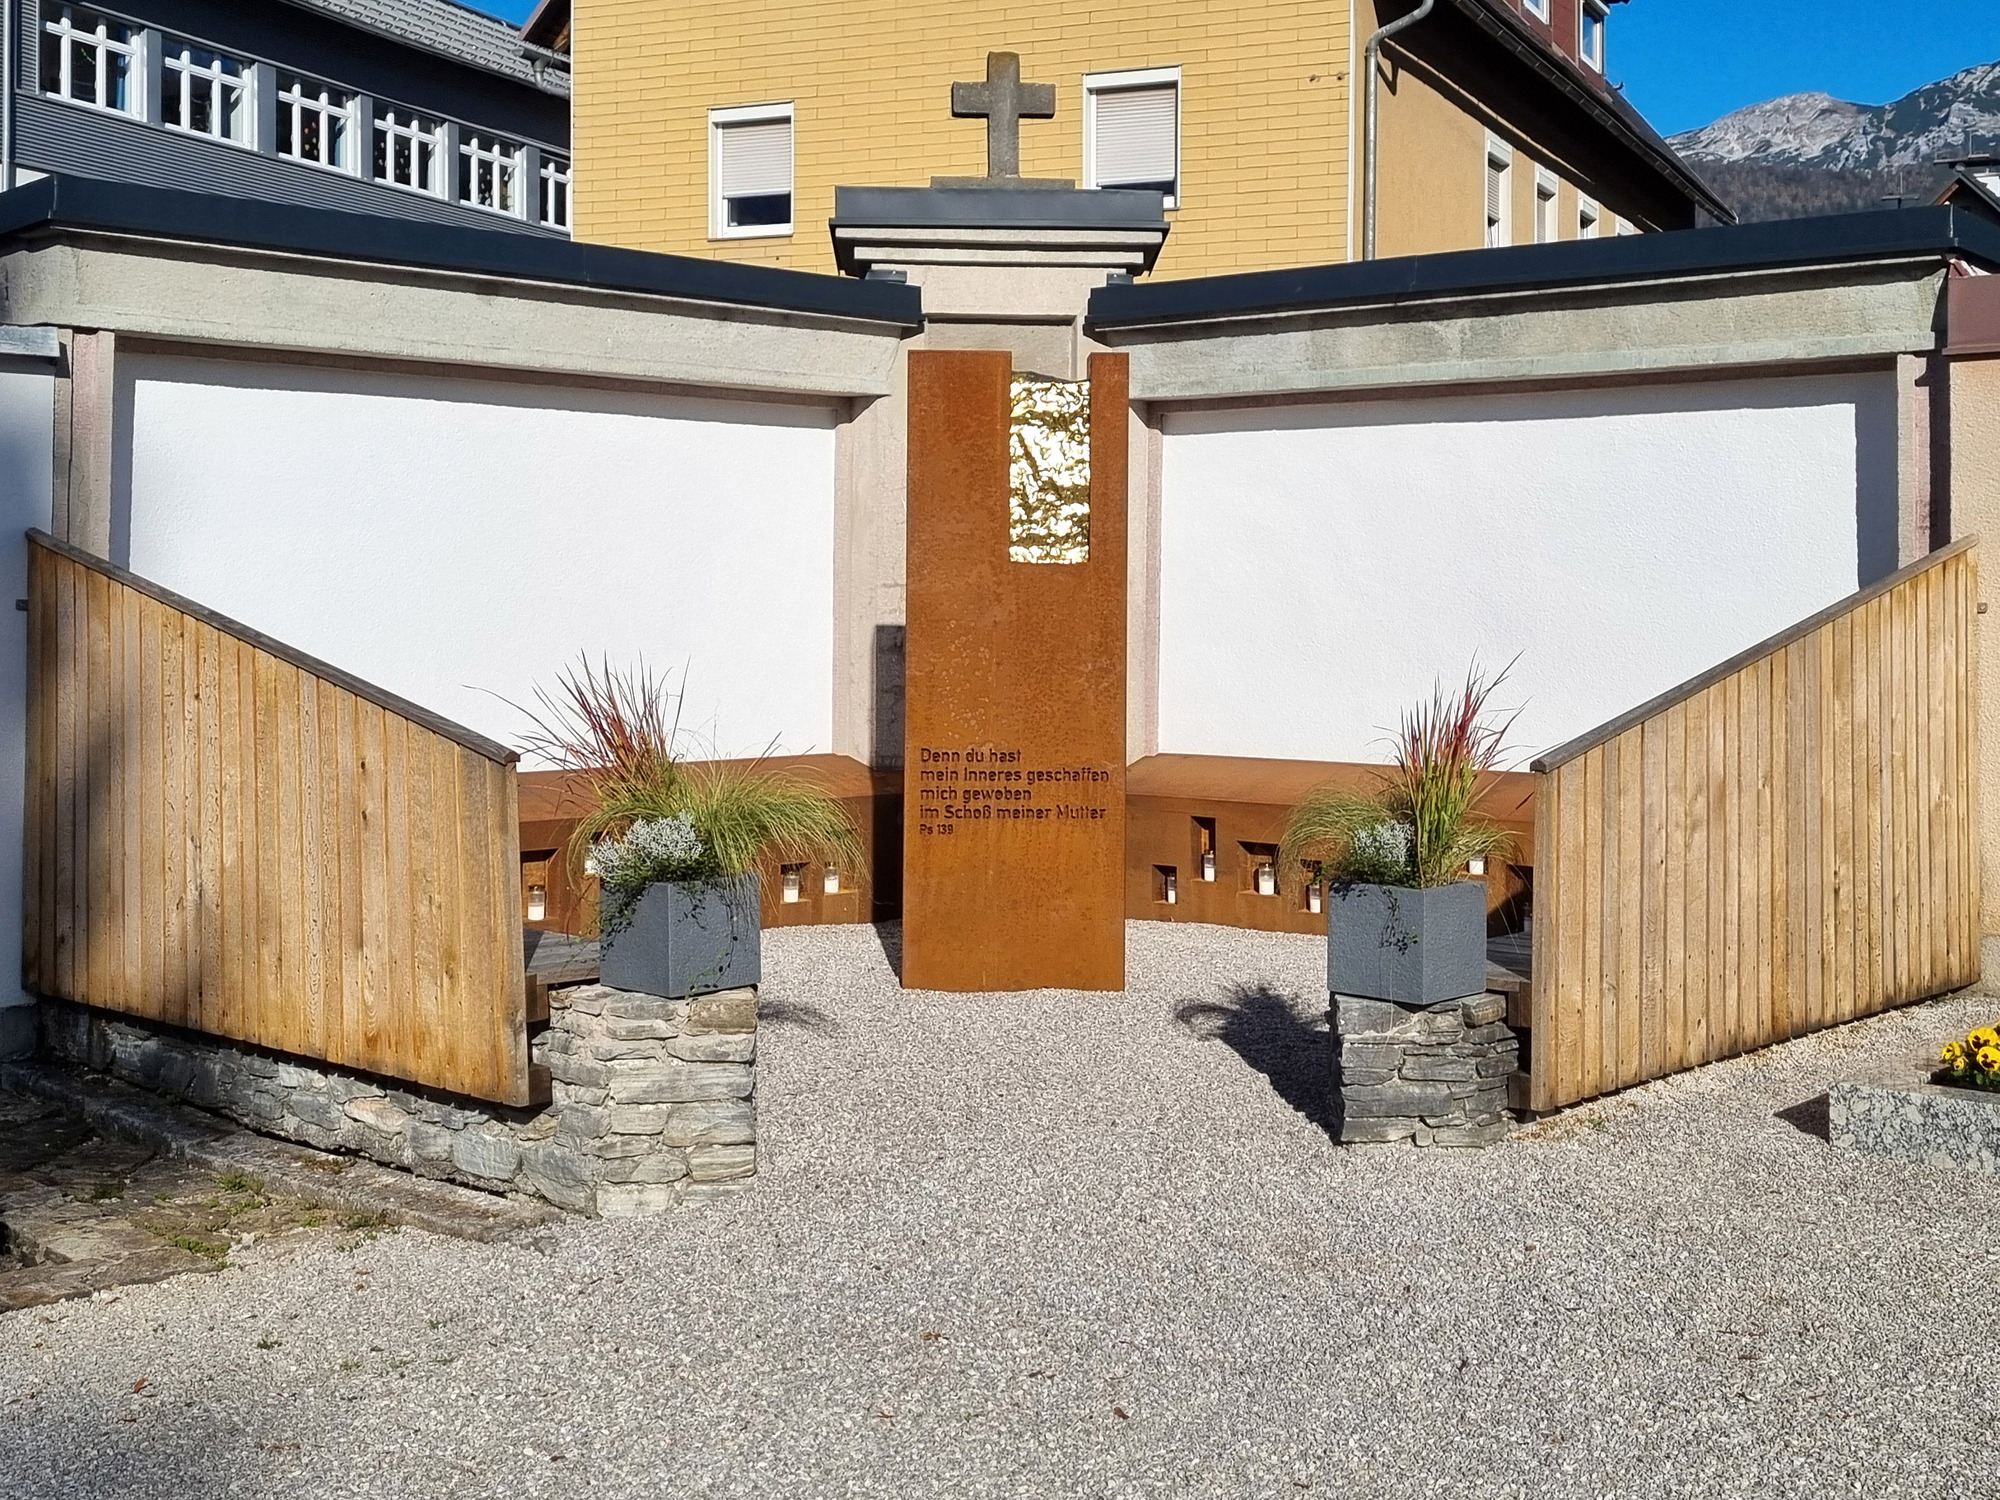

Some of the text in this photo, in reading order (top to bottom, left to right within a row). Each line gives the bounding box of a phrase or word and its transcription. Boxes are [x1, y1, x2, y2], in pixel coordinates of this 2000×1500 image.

[920, 748, 1022, 763] Denn du hast
[920, 767, 1109, 785] mein Inneres geschaffen
[920, 786, 1032, 804] mich gewoben
[920, 804, 1106, 820] im Schoß meiner Mutter
[919, 823, 954, 835] Ps 139
